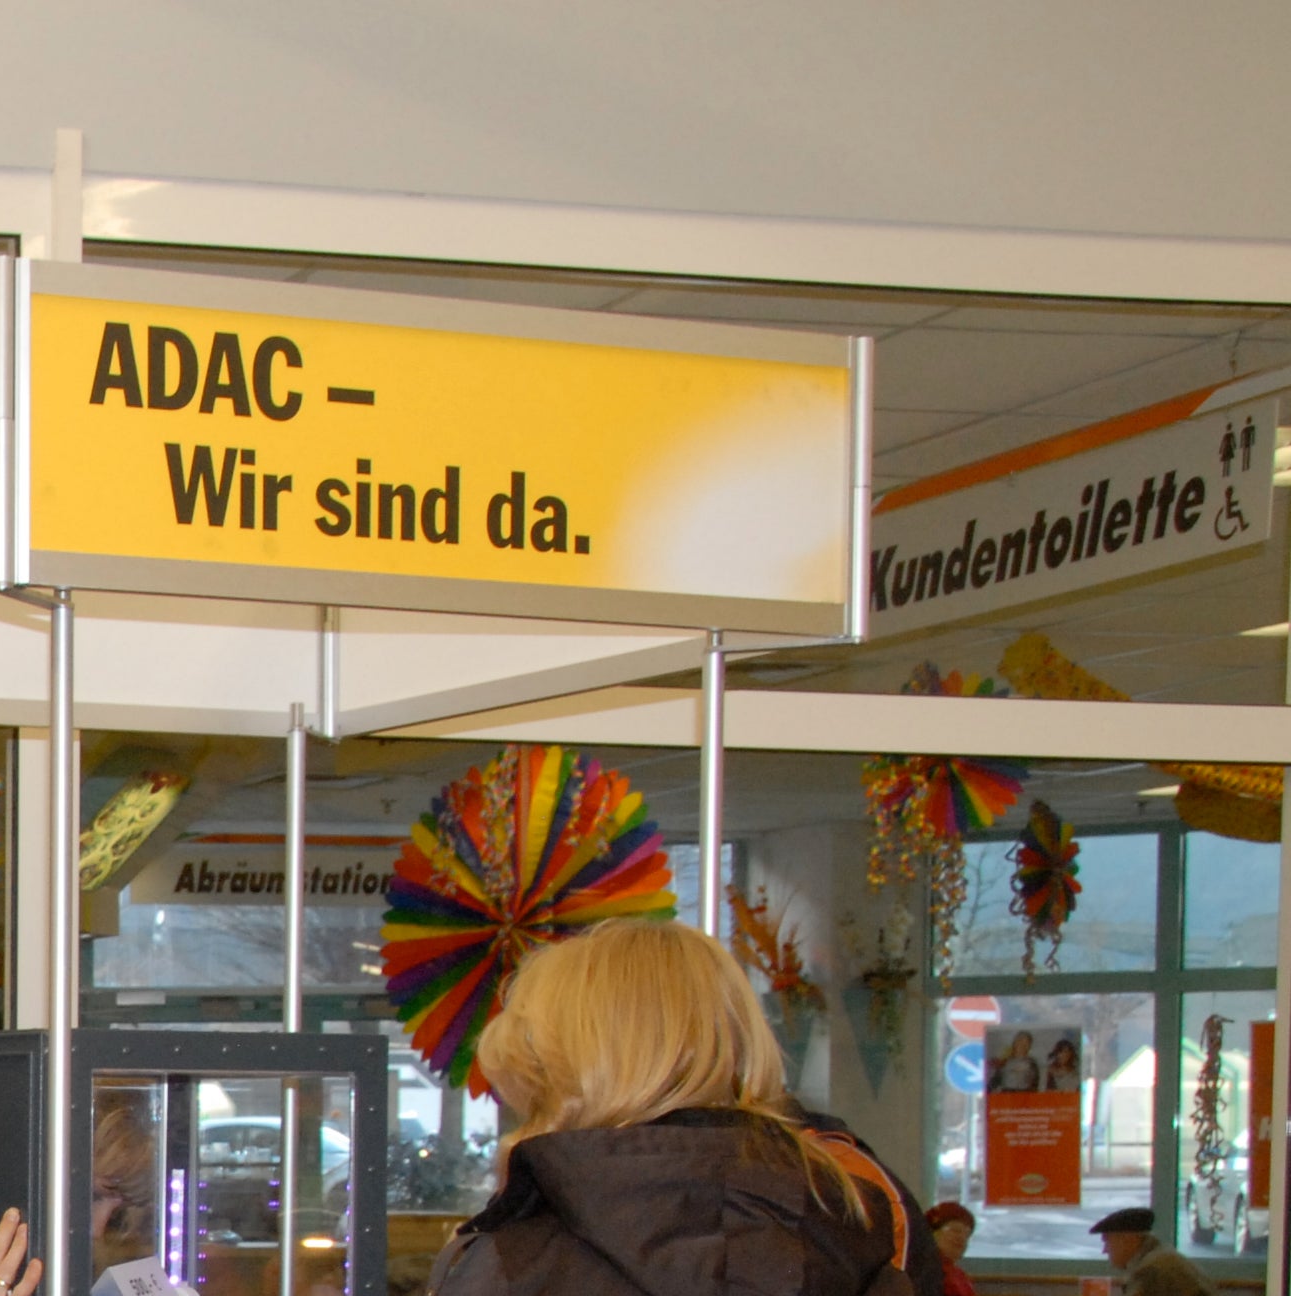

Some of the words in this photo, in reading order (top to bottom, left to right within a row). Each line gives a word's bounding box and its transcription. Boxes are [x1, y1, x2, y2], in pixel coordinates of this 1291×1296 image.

[89, 321, 303, 421] ADAC
[164, 442, 293, 531] Wir
[314, 458, 460, 545] sind
[486, 471, 591, 555] da.
[869, 470, 1206, 612] Kundentoilette
[174, 860, 395, 894] Abräumtation
